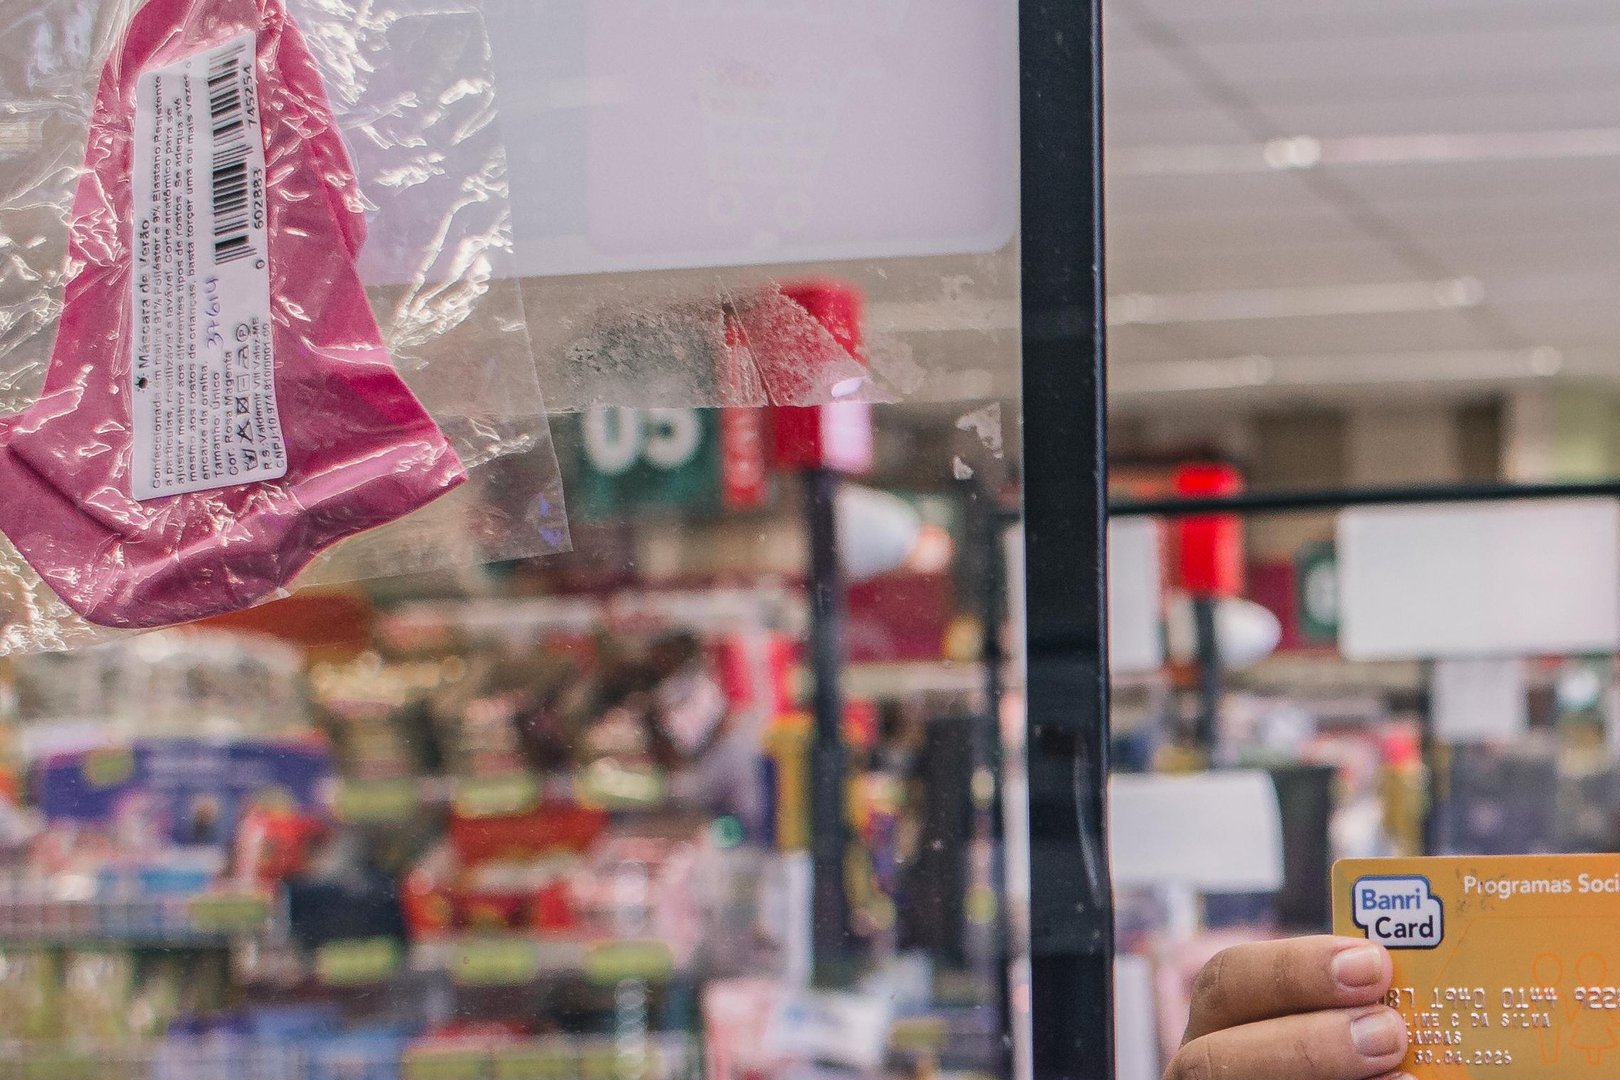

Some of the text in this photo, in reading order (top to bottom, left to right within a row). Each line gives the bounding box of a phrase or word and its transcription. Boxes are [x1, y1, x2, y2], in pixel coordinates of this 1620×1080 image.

[174, 98, 182, 117] até
[183, 74, 192, 110] vezes
[166, 108, 173, 123] se
[185, 114, 194, 144] mais
[165, 128, 175, 153] para
[174, 122, 185, 167] adequa
[186, 148, 193, 163] ou
[174, 171, 182, 188] Se
[242, 64, 265, 270] 0 602883 745254
[162, 158, 172, 224] anatômico
[164, 228, 172, 263] Corte
[175, 241, 184, 256] de
[187, 242, 195, 277] basta
[138, 273, 151, 294] de
[176, 260, 186, 292] tipos
[176, 295, 185, 360] diferentes
[205, 276, 224, 350] 37614
[138, 299, 151, 369] Máscara
[188, 344, 196, 359] de
[189, 363, 197, 404] rostos
[209, 372, 220, 410] Único
[224, 351, 235, 406] Magenta
[176, 392, 185, 436] melhor
[189, 409, 197, 432] aos
[200, 410, 208, 426] da
[224, 411, 233, 443] Rosa
[176, 440, 186, 485] ajustar
[200, 430, 210, 480] encaixe
[1361, 887, 1421, 910] Banri
[1463, 873, 1572, 900] Programas
[1375, 915, 1434, 940] Card
[1501, 986, 1559, 1010] 0144
